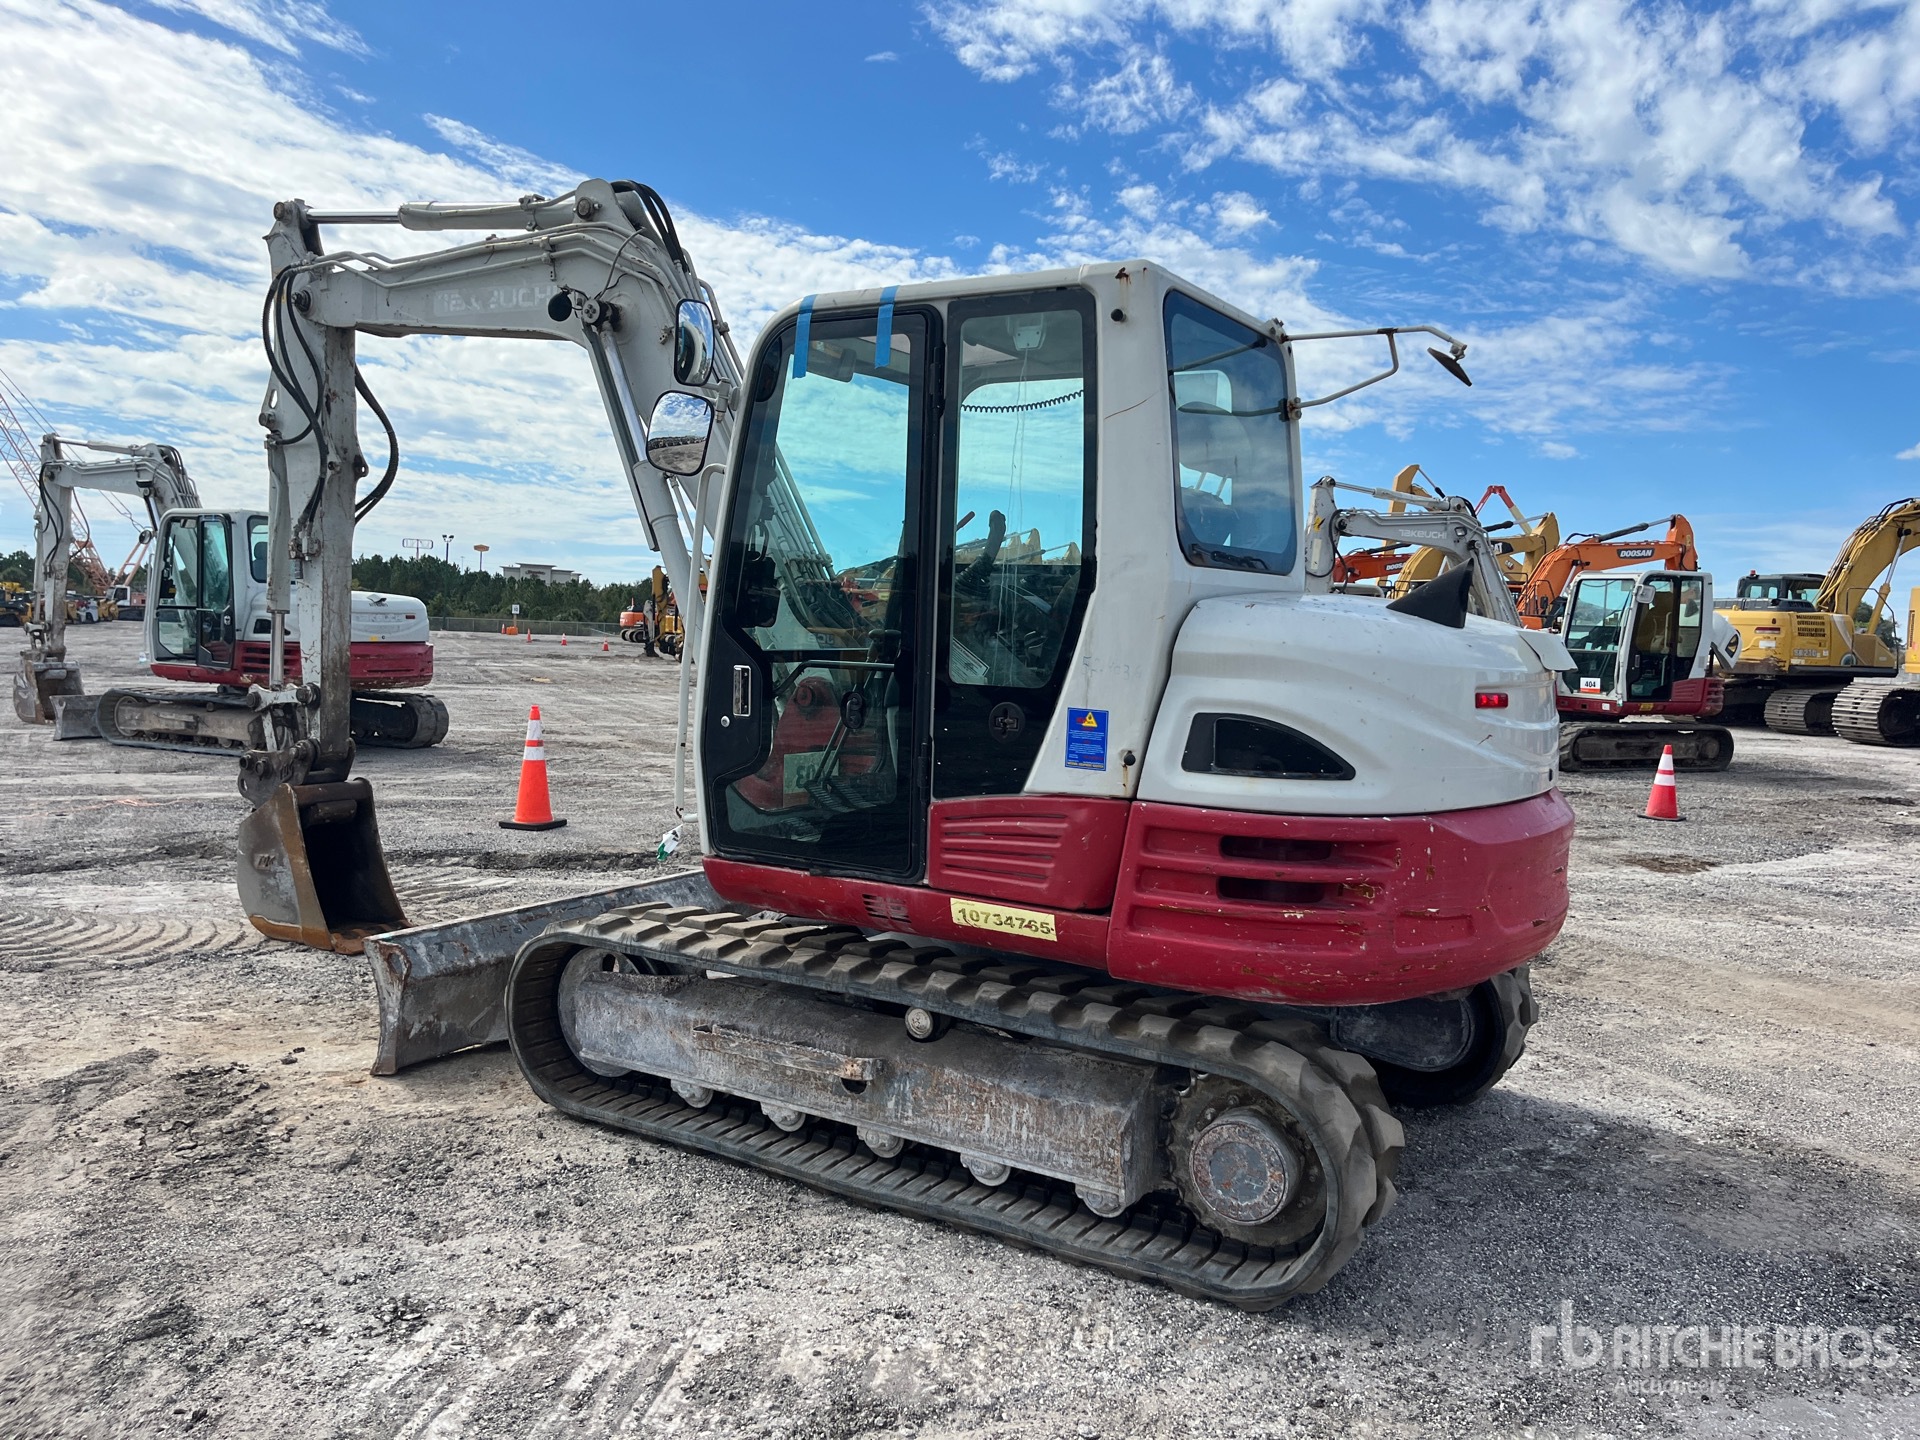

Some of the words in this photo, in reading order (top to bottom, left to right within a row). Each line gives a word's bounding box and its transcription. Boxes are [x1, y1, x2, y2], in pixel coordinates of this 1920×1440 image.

[1398, 529, 1447, 539] TAKEUCHI
[1620, 549, 1653, 557] DOOSAN
[958, 908, 1051, 934] 10734765
